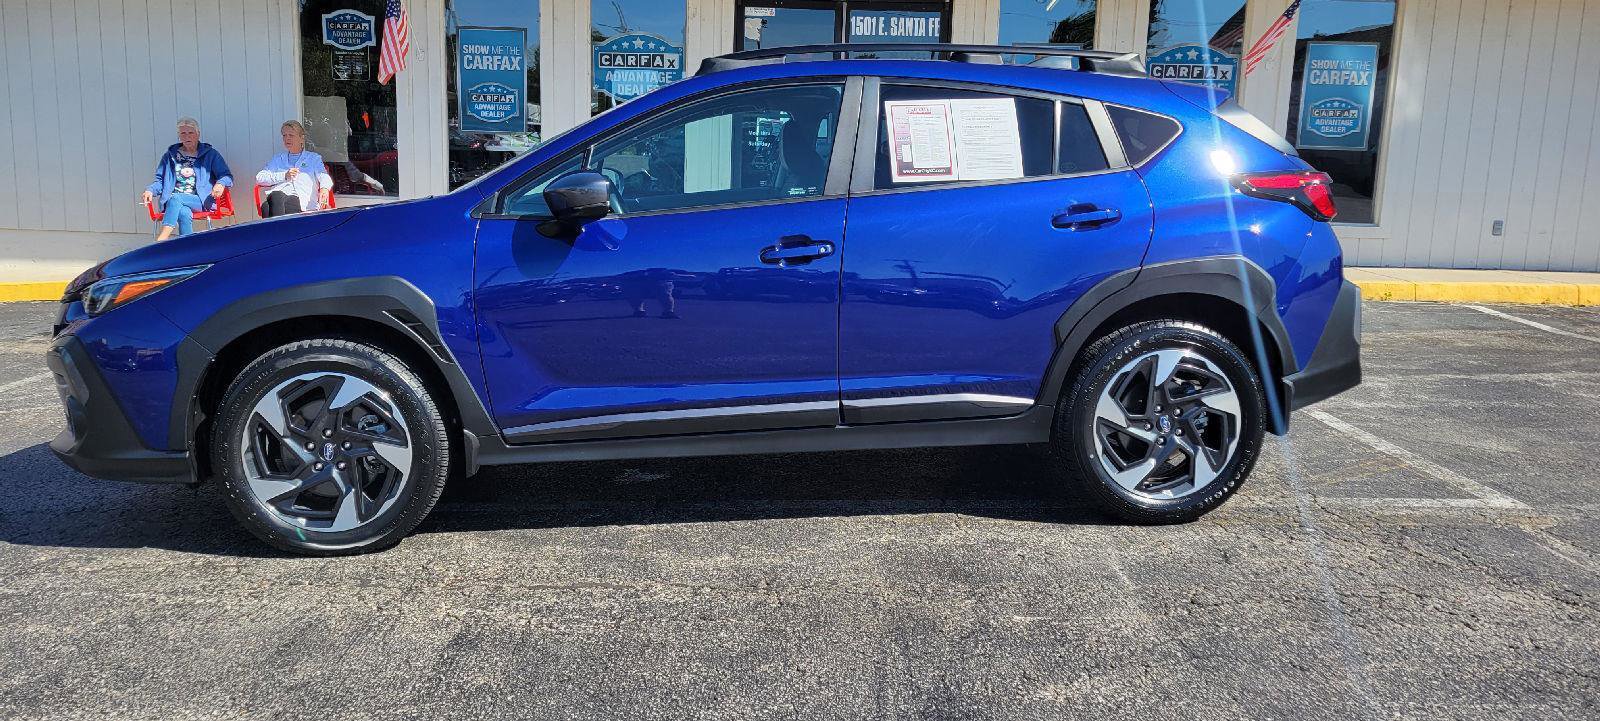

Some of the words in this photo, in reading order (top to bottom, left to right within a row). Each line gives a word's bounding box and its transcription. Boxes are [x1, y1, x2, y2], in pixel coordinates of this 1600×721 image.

[329, 23, 368, 31] CARFAX
[851, 16, 876, 36] 1501
[879, 16, 888, 36] E.
[890, 17, 926, 36] SANTA
[929, 17, 940, 36] FE
[462, 44, 489, 55] SHOW
[491, 46, 503, 55] ME
[505, 46, 520, 56] THE
[463, 55, 521, 71] CARFAX
[601, 54, 676, 68] CARFAX
[1311, 60, 1339, 70] SHOW
[1340, 60, 1352, 70] ME
[1356, 61, 1371, 71] THE
[605, 70, 673, 83] ADVANTAGE
[1152, 66, 1229, 79] CARFAX
[1310, 70, 1370, 86] CARFAX
[617, 84, 657, 95] DEALE
[472, 95, 513, 103] CARFAX
[474, 103, 511, 111] ADVANTAGE
[1314, 110, 1357, 118] CARFAX
